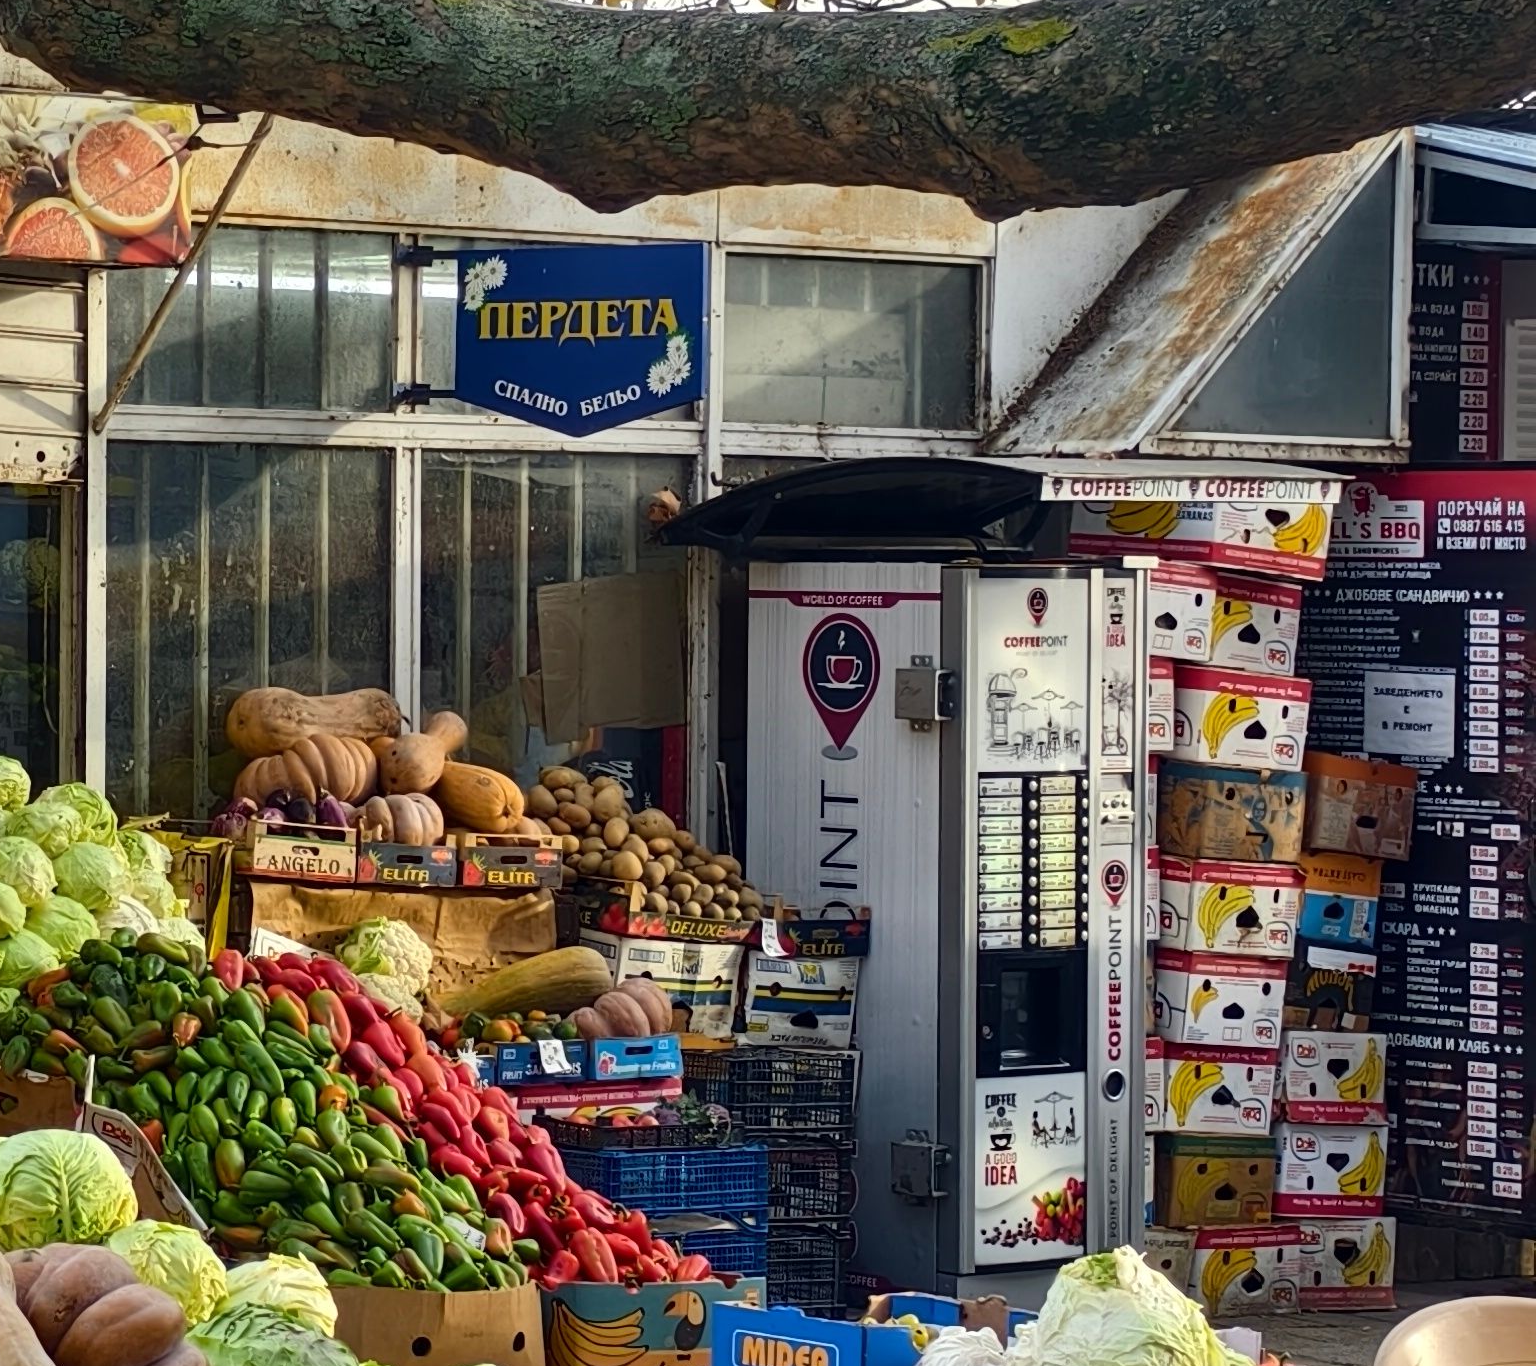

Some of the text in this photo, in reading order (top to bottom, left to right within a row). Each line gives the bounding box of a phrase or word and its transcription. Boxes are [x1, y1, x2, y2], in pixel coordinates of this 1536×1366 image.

[1416, 263, 1454, 287] ТКИ
[479, 298, 679, 347] ПЕРДЕТА
[494, 380, 641, 417] СПАЛНО БЕЛЬО
[1437, 497, 1526, 516] ПОРЪЧАЙ НА
[1380, 522, 1421, 540] BBQ
[1505, 519, 1525, 533] 415
[1436, 537, 1527, 551] И ВЗЕМИ ОТ МЯСТО
[802, 595, 883, 607] WORLD OF COFFEE
[1335, 588, 1470, 604] ДЖОБОВЕ (САНДВИЧИ)
[1004, 635, 1068, 649] COFFEEPOINT
[267, 855, 340, 875] ANGELO
[671, 920, 726, 937] DELUXE
[1446, 1038, 1455, 1051] И
[502, 1070, 523, 1080] FRUIT
[985, 1093, 1017, 1109] COFFEE
[101, 1119, 133, 1145] Dole
[985, 1165, 1017, 1186] IDEA
[850, 1275, 878, 1288] OFFEE
